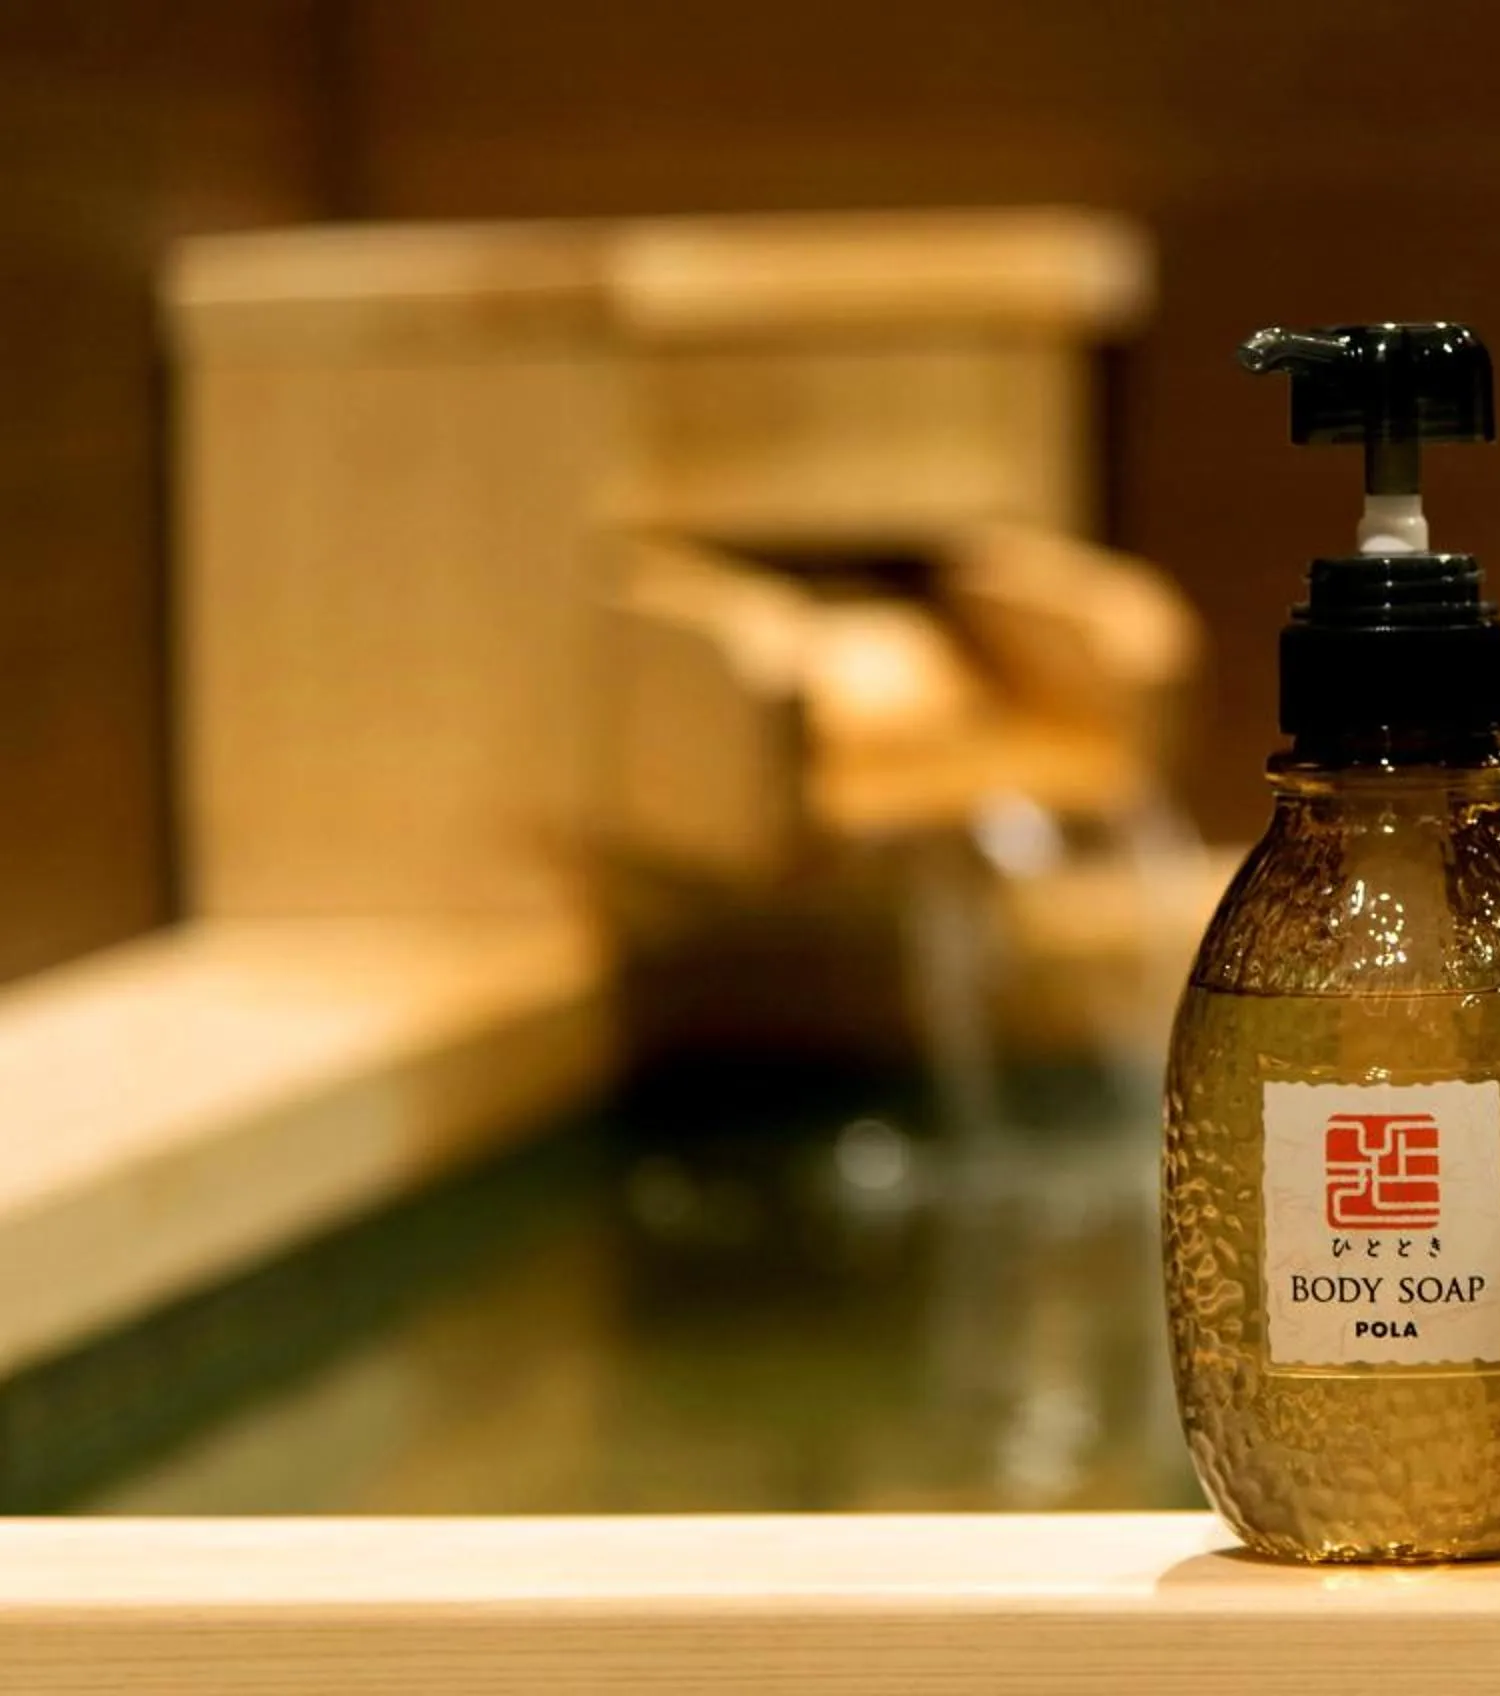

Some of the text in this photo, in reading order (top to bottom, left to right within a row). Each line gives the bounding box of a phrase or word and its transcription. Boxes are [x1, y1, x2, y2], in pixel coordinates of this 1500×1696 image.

[1332, 1237, 1441, 1258] ひととき
[1291, 1276, 1485, 1304] BODY SOAP
[1355, 1321, 1419, 1338] POLA
